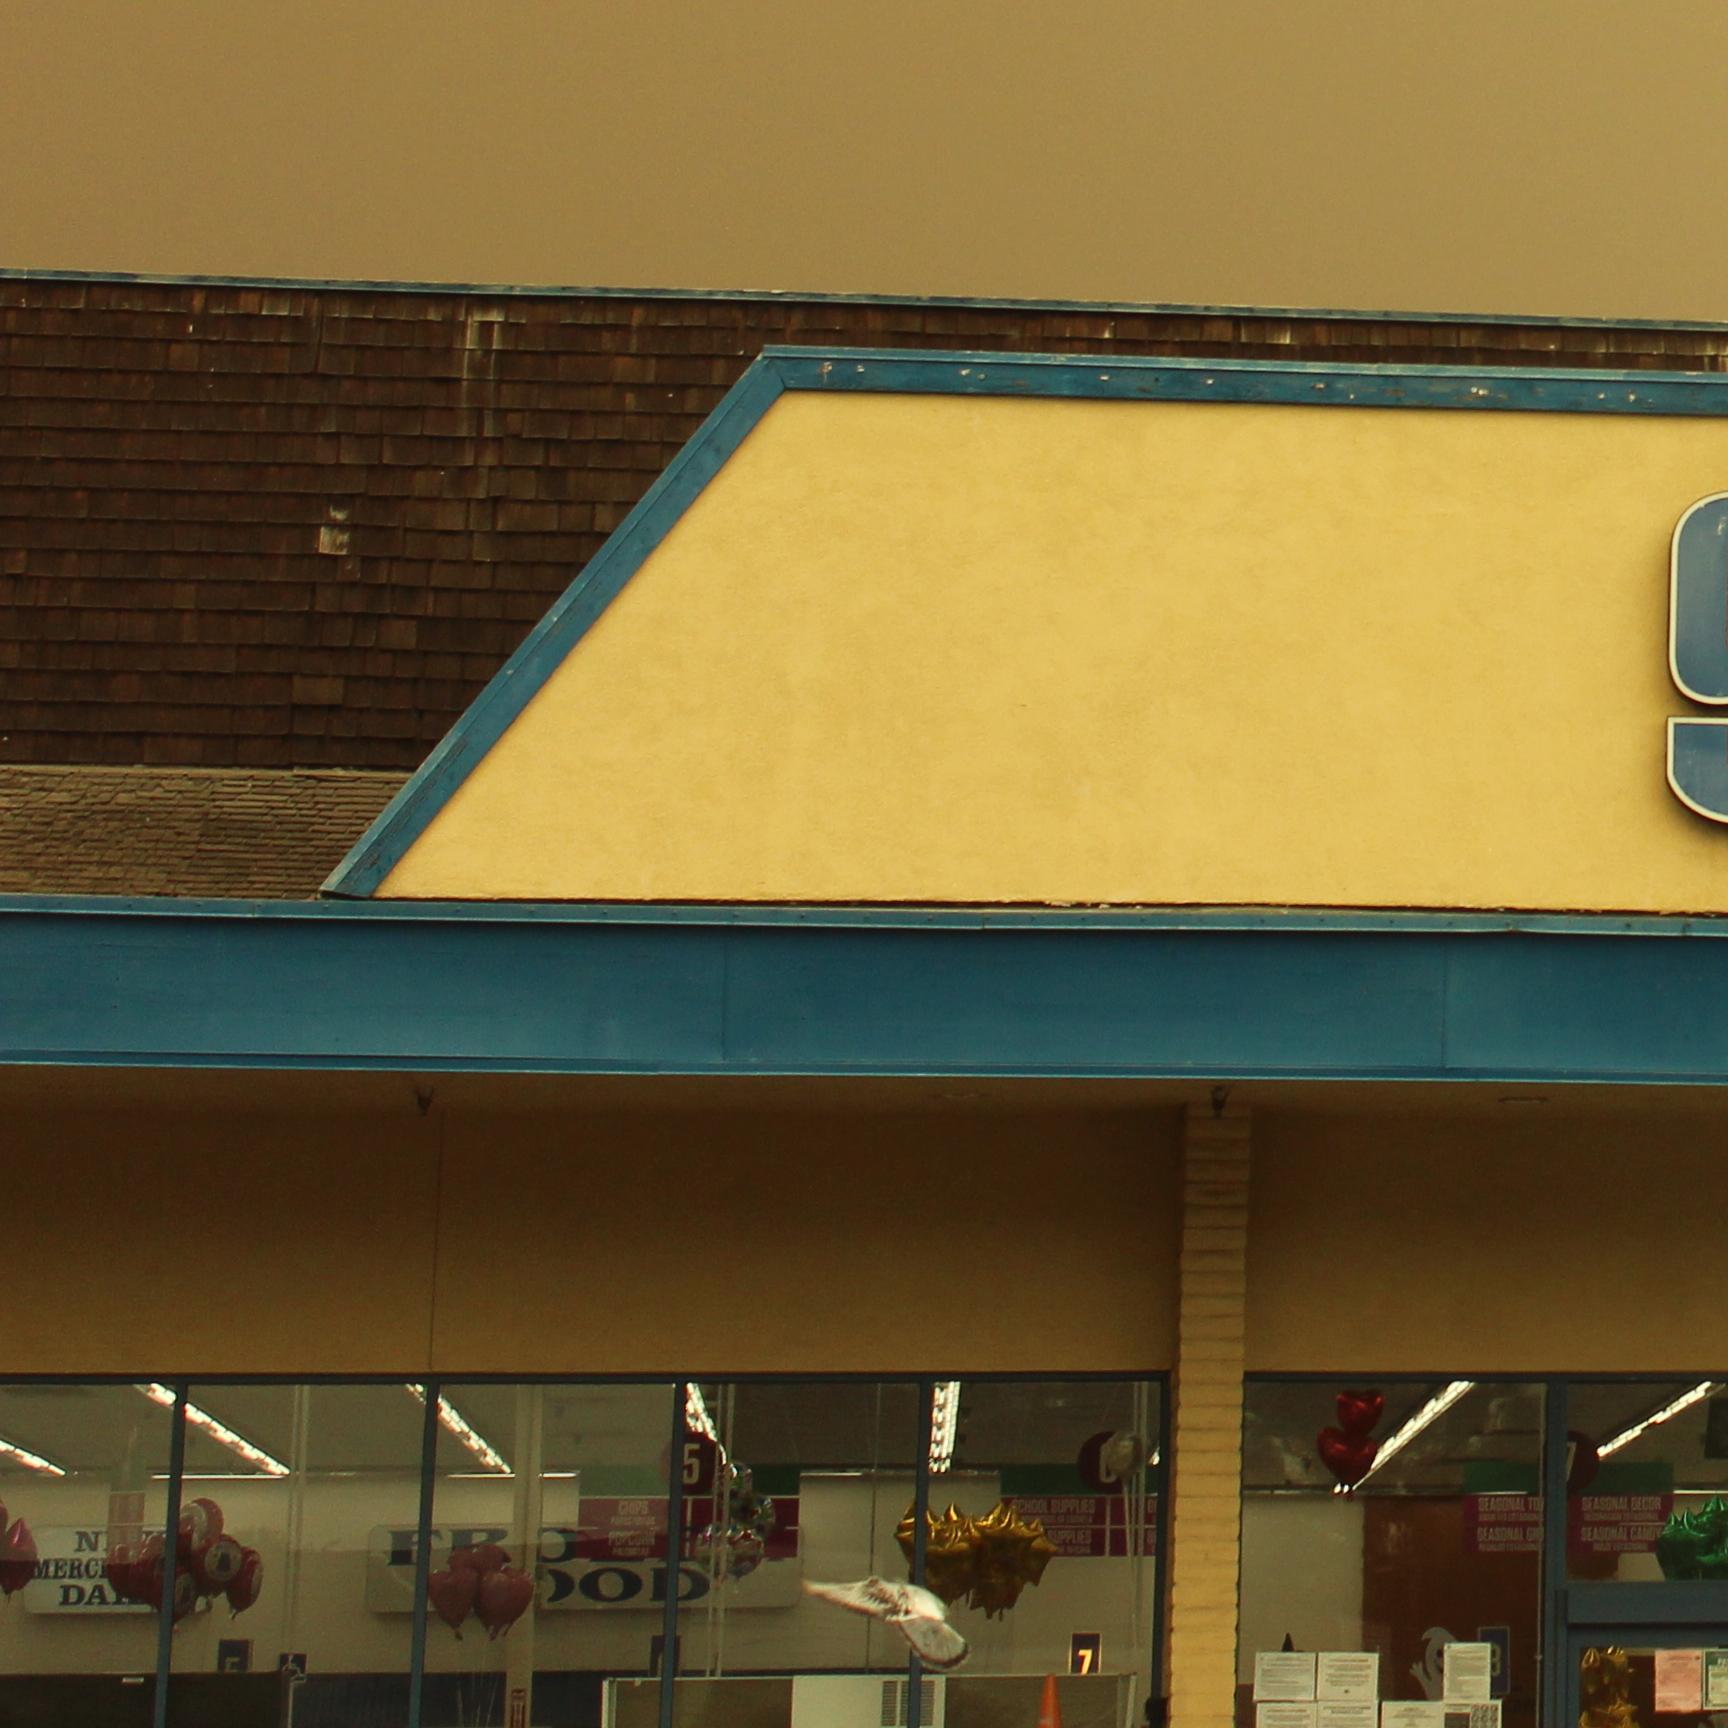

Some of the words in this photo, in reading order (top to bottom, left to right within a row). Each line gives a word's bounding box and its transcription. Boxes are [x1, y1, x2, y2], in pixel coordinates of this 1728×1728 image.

[684, 1444, 700, 1485] 5
[618, 1500, 649, 1516] CHIPS
[1051, 1499, 1095, 1513] SUPPLIES
[1478, 1497, 1526, 1512] SEASONAL
[1582, 1496, 1629, 1512] SEASONAL
[1631, 1496, 1661, 1512] DECOR
[608, 1530, 656, 1546] POPCORN
[1477, 1527, 1524, 1543] SEASONAL
[1581, 1526, 1628, 1542] SEASONAL
